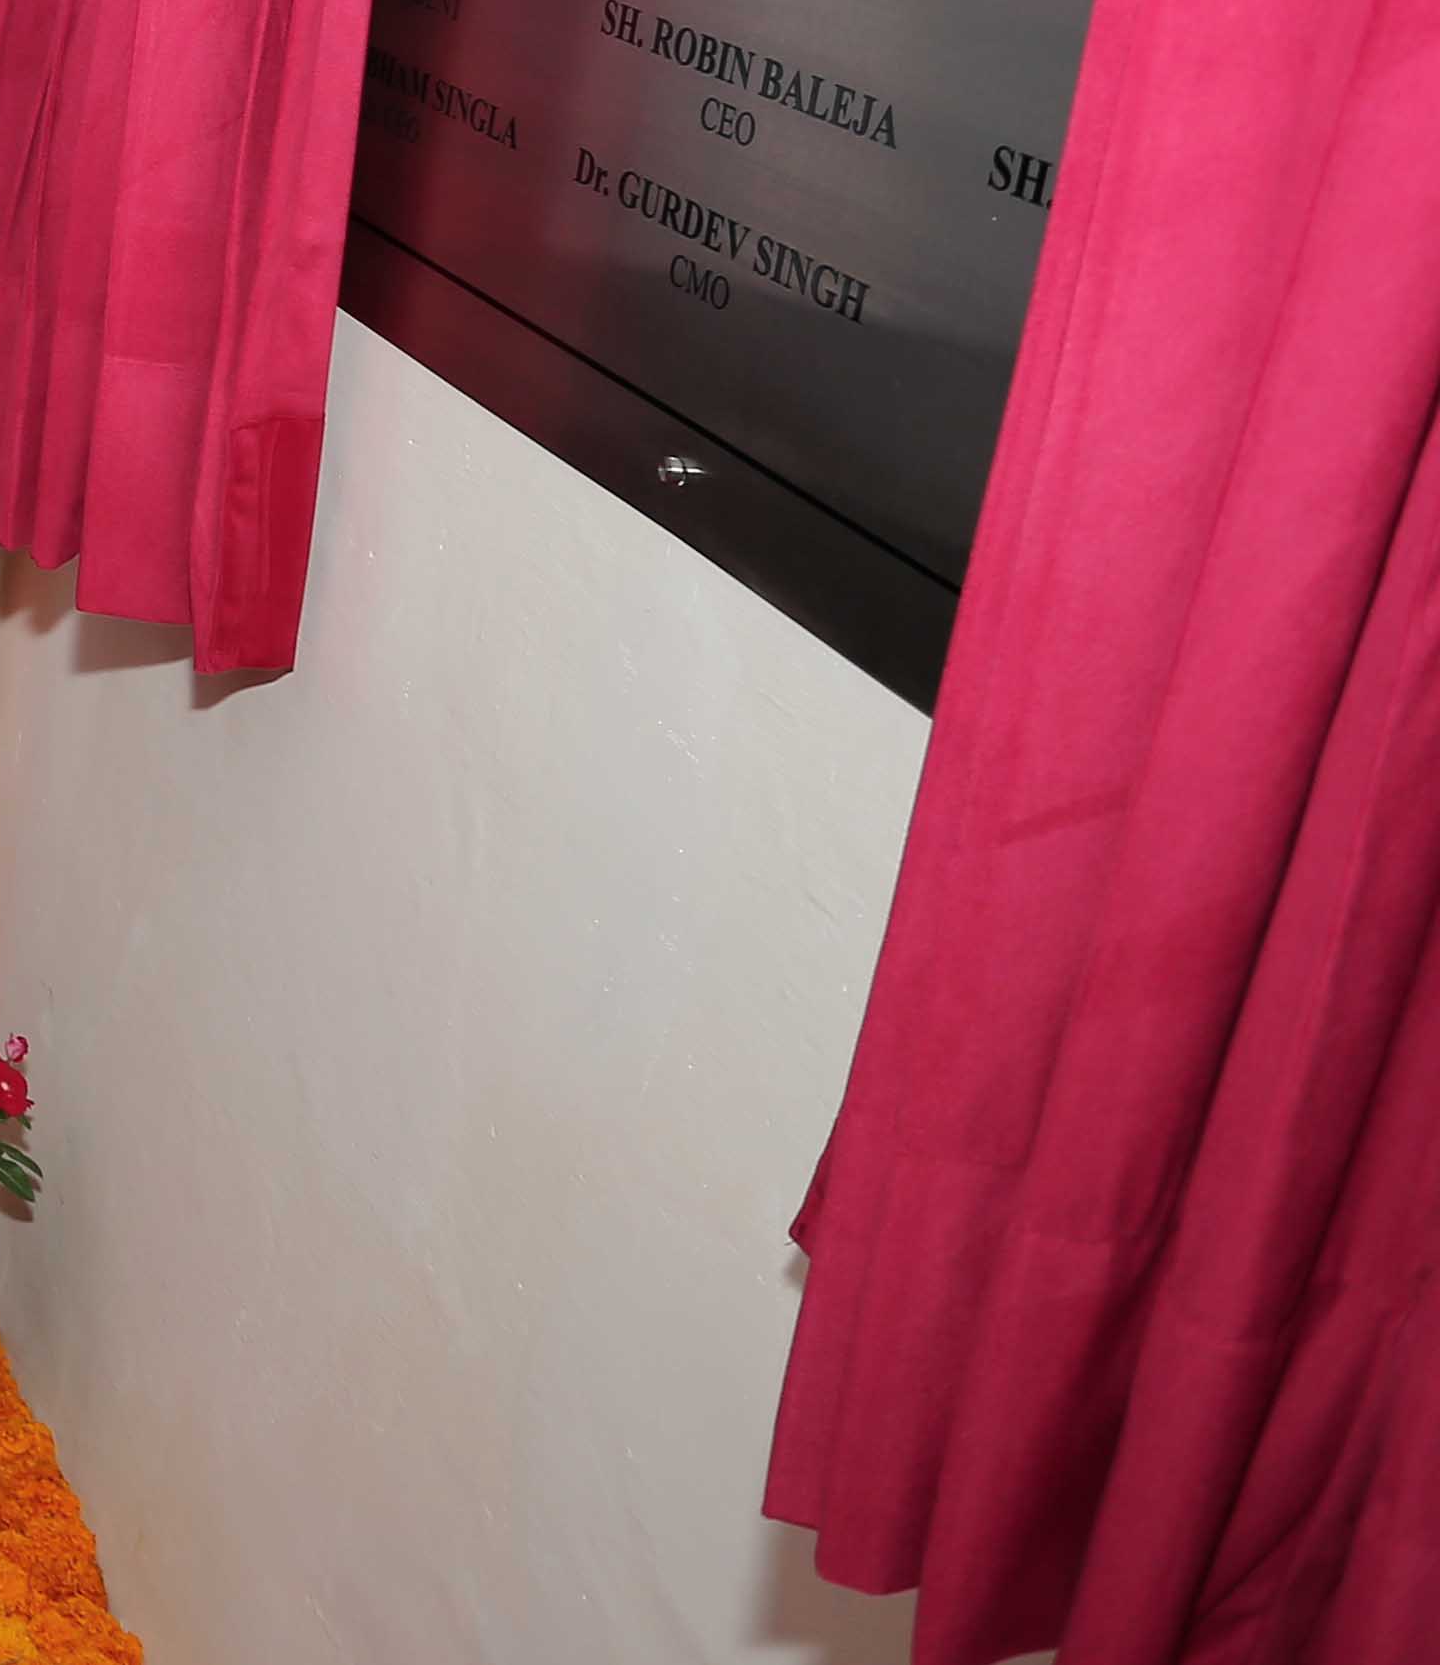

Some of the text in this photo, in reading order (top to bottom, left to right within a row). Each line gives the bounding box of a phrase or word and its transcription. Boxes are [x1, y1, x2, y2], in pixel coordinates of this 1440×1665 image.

[601, 0, 896, 149] SH. ROBIN BALEJA
[433, 79, 518, 150] SINGLA
[701, 97, 755, 146] CEO
[573, 148, 870, 325] Dr. GURDEV SINGH
[670, 255, 730, 310] CMO
